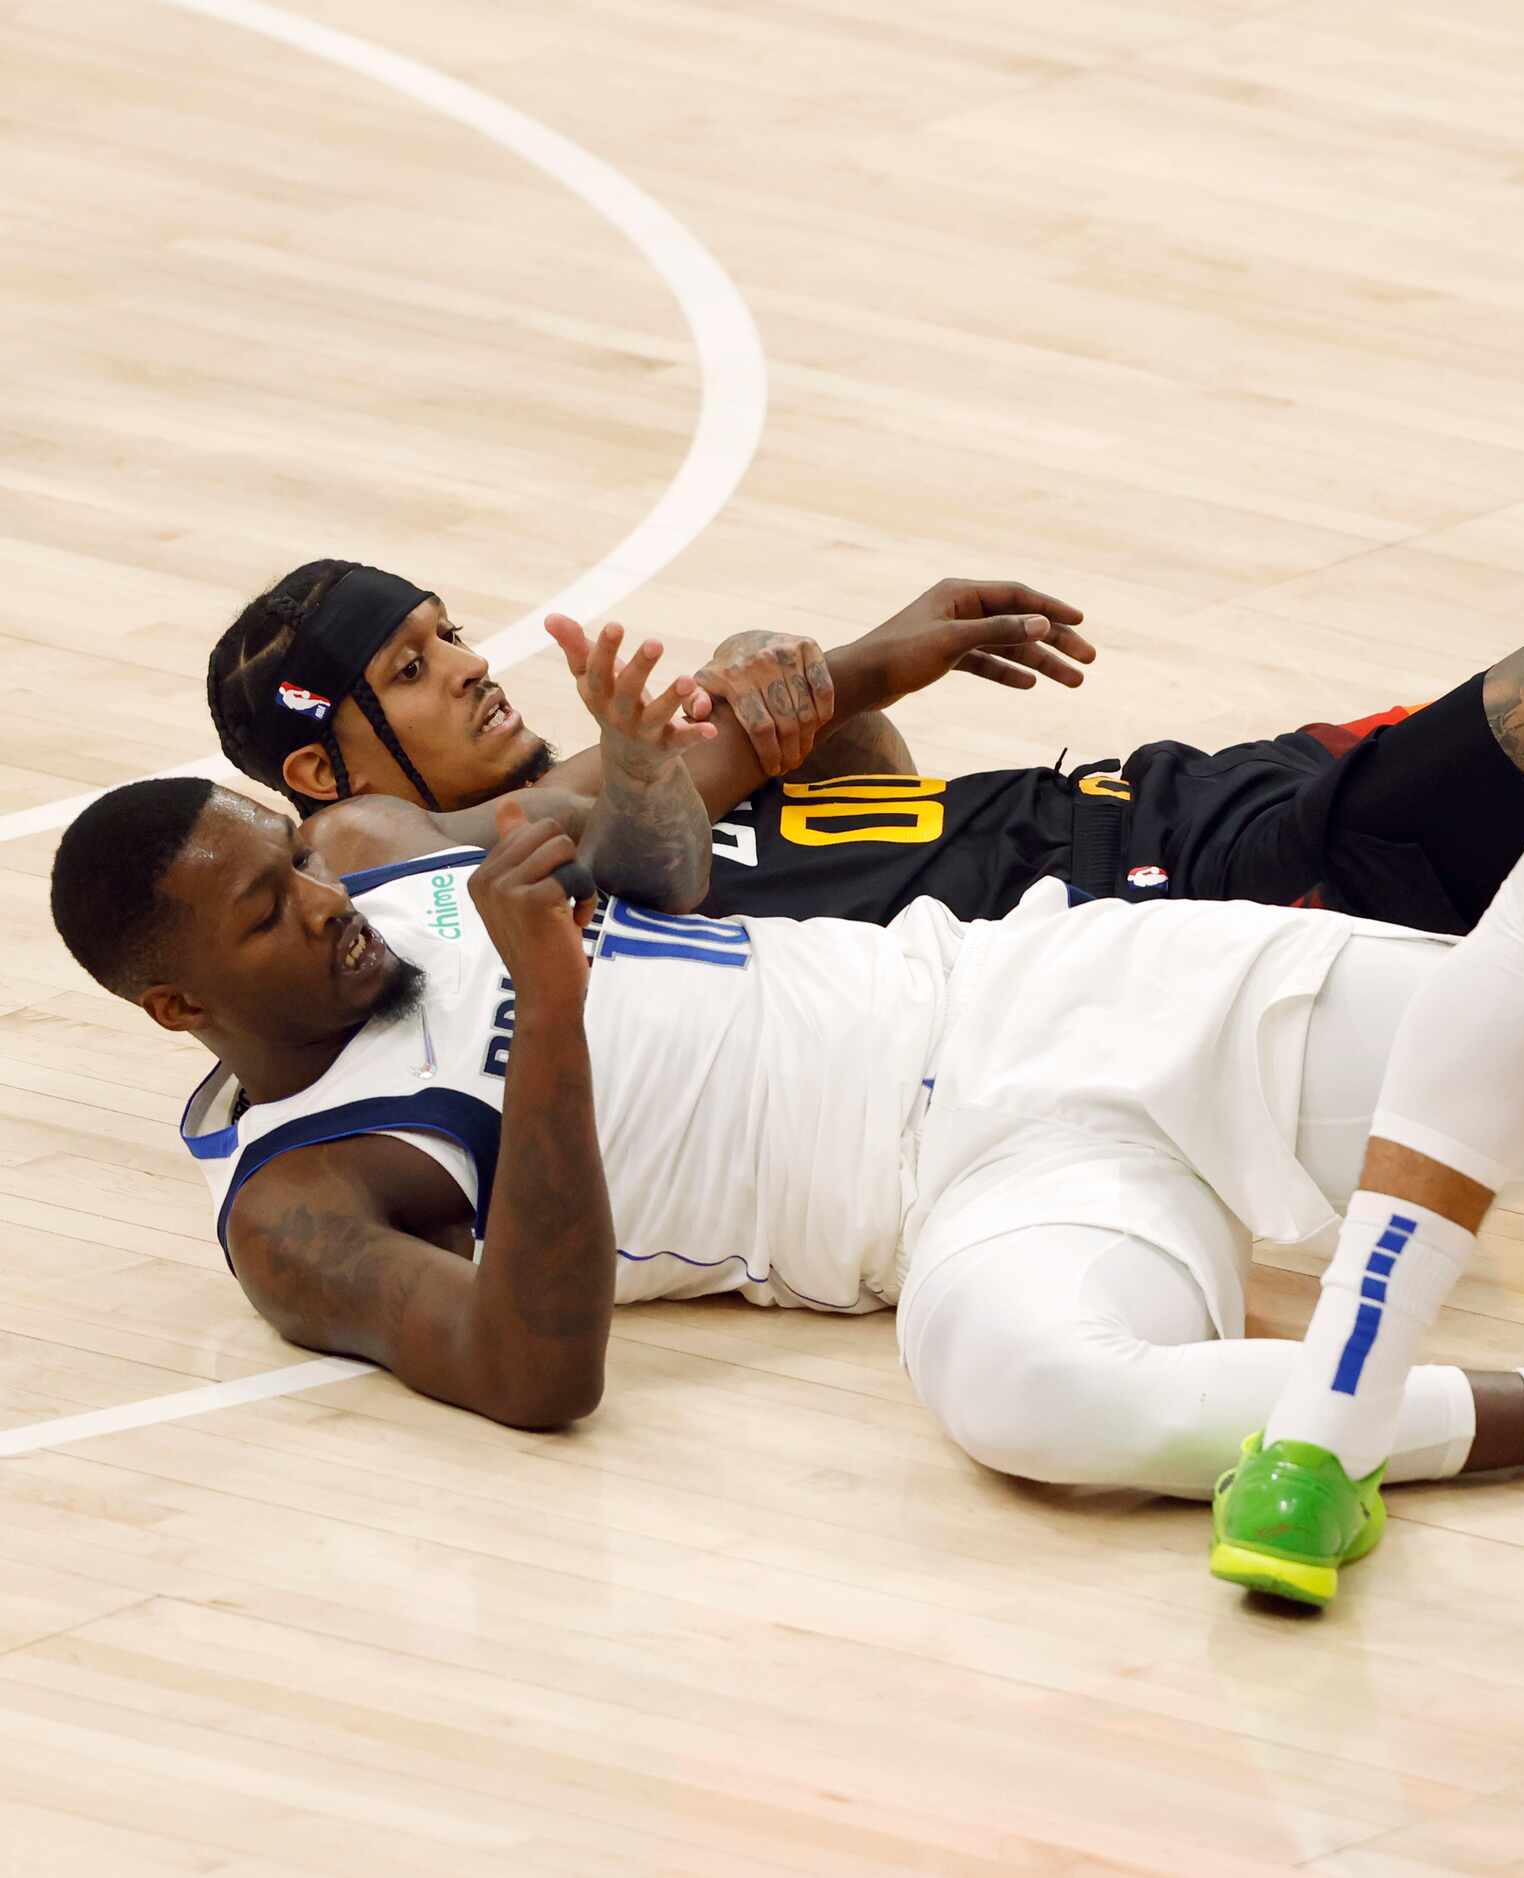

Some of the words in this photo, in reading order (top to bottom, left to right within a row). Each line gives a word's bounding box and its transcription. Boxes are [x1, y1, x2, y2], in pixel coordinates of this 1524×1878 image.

[780, 774, 947, 846] 00
[427, 873, 461, 940] chime
[598, 895, 752, 970] 10
